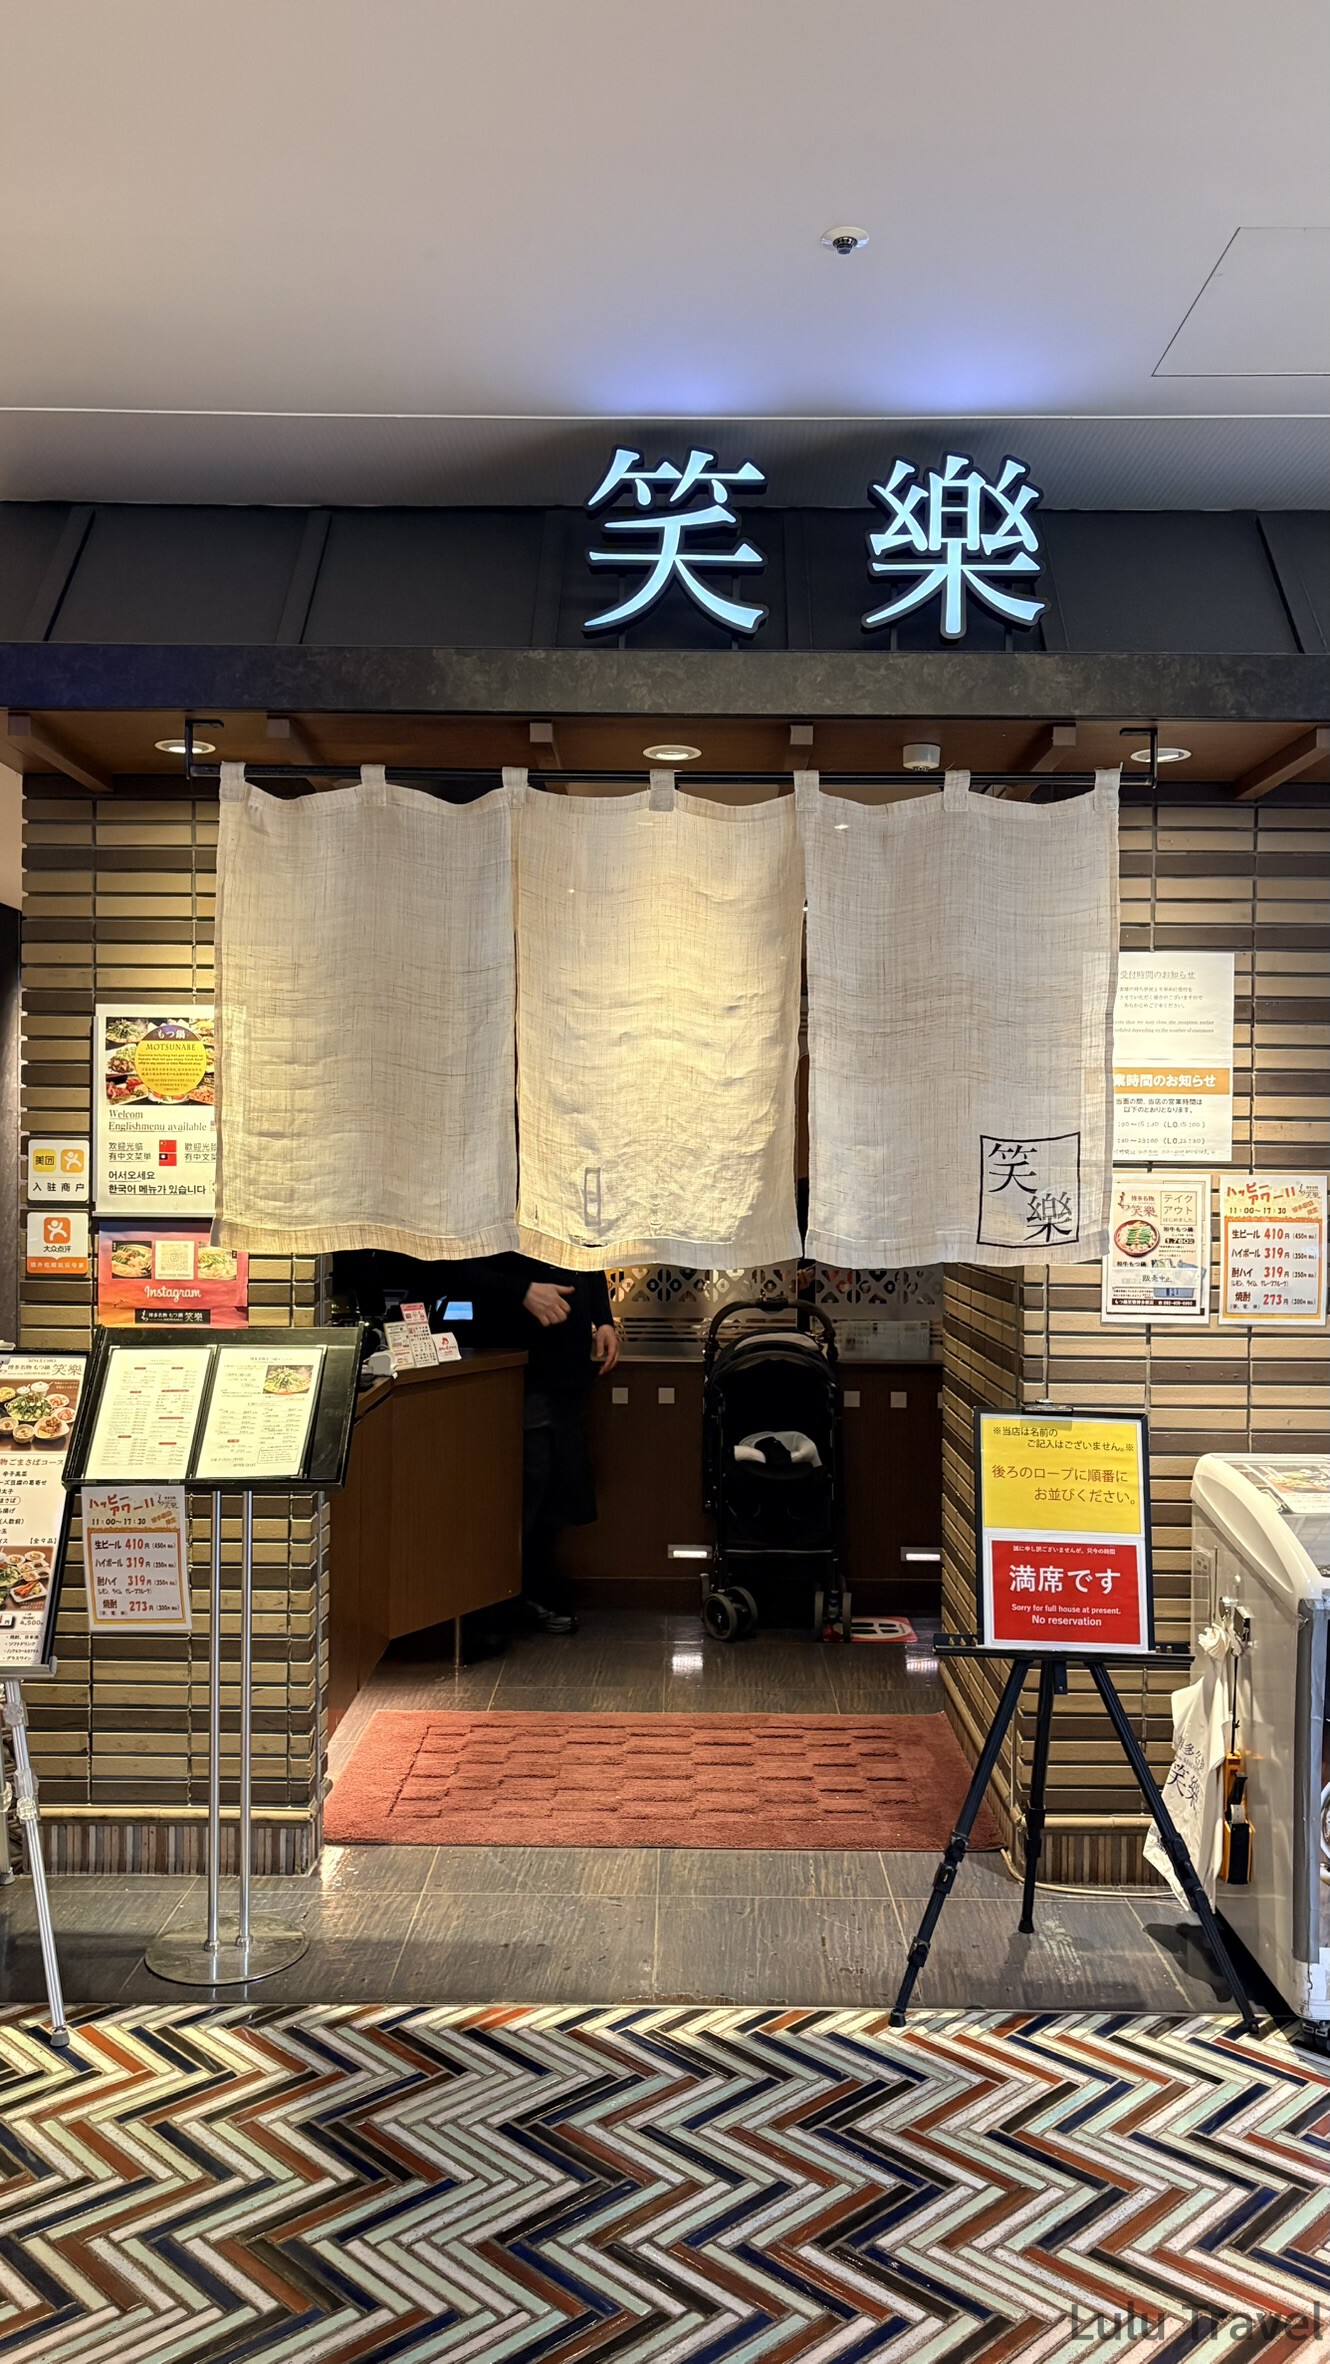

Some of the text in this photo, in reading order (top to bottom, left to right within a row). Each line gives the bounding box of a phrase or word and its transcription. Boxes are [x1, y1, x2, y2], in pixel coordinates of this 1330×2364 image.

[583, 447, 1046, 634] 笑樂
[158, 1029, 186, 1039] もつ鍋
[146, 1043, 196, 1051] MOTSUNABE
[109, 1109, 144, 1119] Welcom
[167, 1122, 207, 1131] available
[108, 1171, 155, 1180] 어서오세요
[33, 1182, 84, 1192] 入驻商户
[108, 1184, 206, 1194] 한국어 메뉴가 있습니다
[988, 1143, 1072, 1242] 笑樂
[1163, 1194, 1193, 1203] テイク
[1163, 1206, 1193, 1215] アウト
[1232, 1229, 1260, 1239] 生ビール
[144, 1285, 202, 1303] Instagram
[992, 1464, 1128, 1483] 後ろのロープに順番に
[1034, 1487, 1135, 1505] お並びください。
[94, 1540, 121, 1550] 生ビール
[1009, 1564, 1121, 1594] 満席です
[1011, 1603, 1031, 1612] Sorry
[1033, 1604, 1044, 1612] for
[1045, 1604, 1057, 1612] full
[1058, 1605, 1080, 1613] house
[1091, 1607, 1121, 1615] present.
[1031, 1615, 1102, 1626] No reservation
